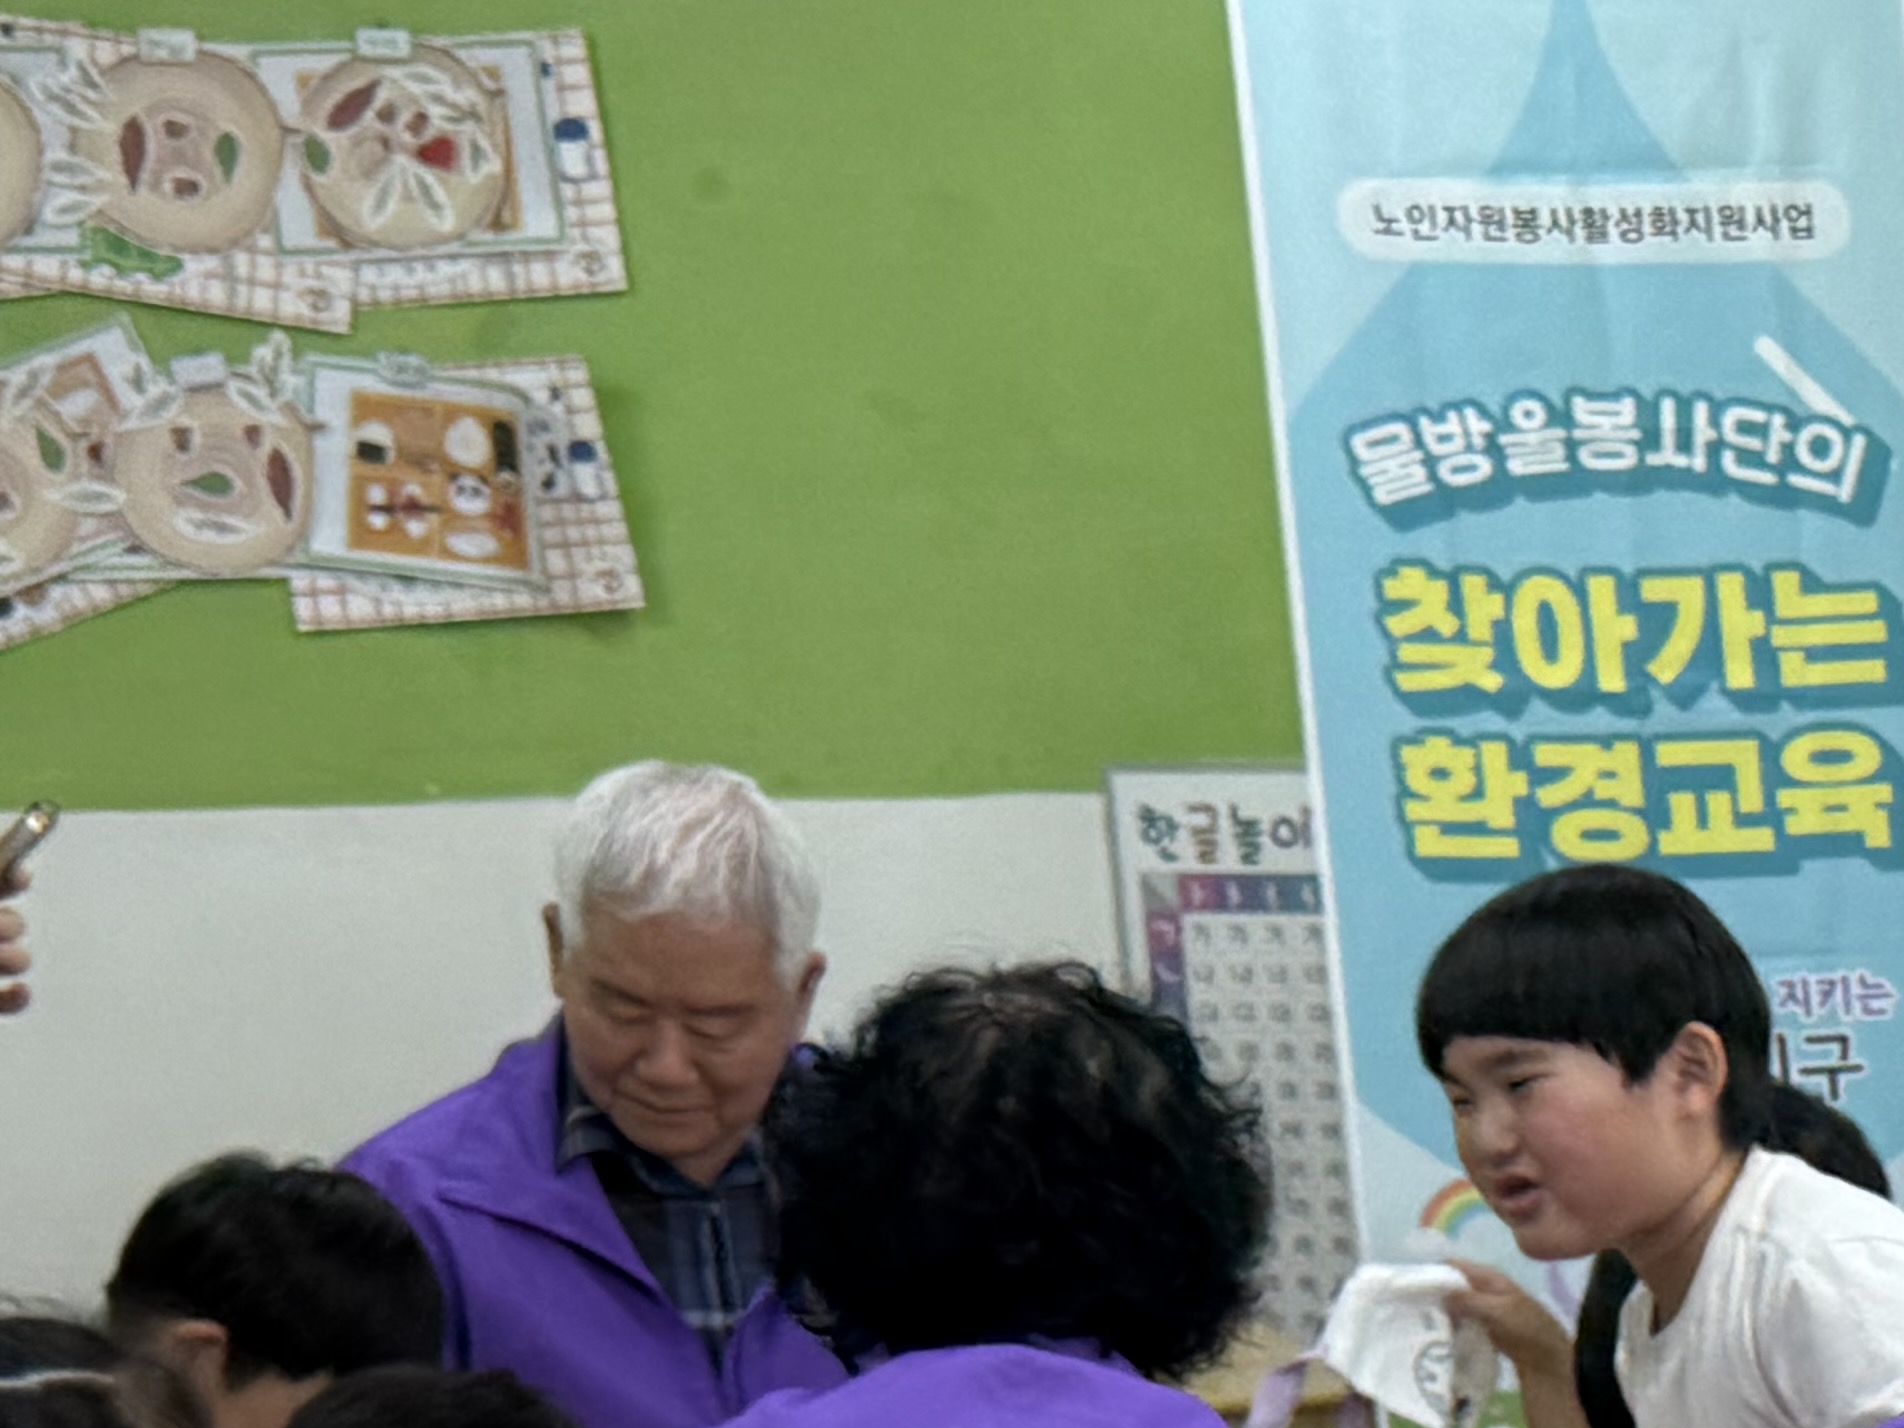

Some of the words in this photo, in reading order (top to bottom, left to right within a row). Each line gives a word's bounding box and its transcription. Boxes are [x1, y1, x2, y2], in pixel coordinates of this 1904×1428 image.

[1374, 204, 1814, 244] 노인자원봉사활성화지원사업
[1350, 394, 1865, 506] 물방울봉사단의
[1380, 565, 1888, 694] 찾아가는
[1398, 729, 1894, 862] 환경교육
[1776, 972, 1895, 1017] 지키는
